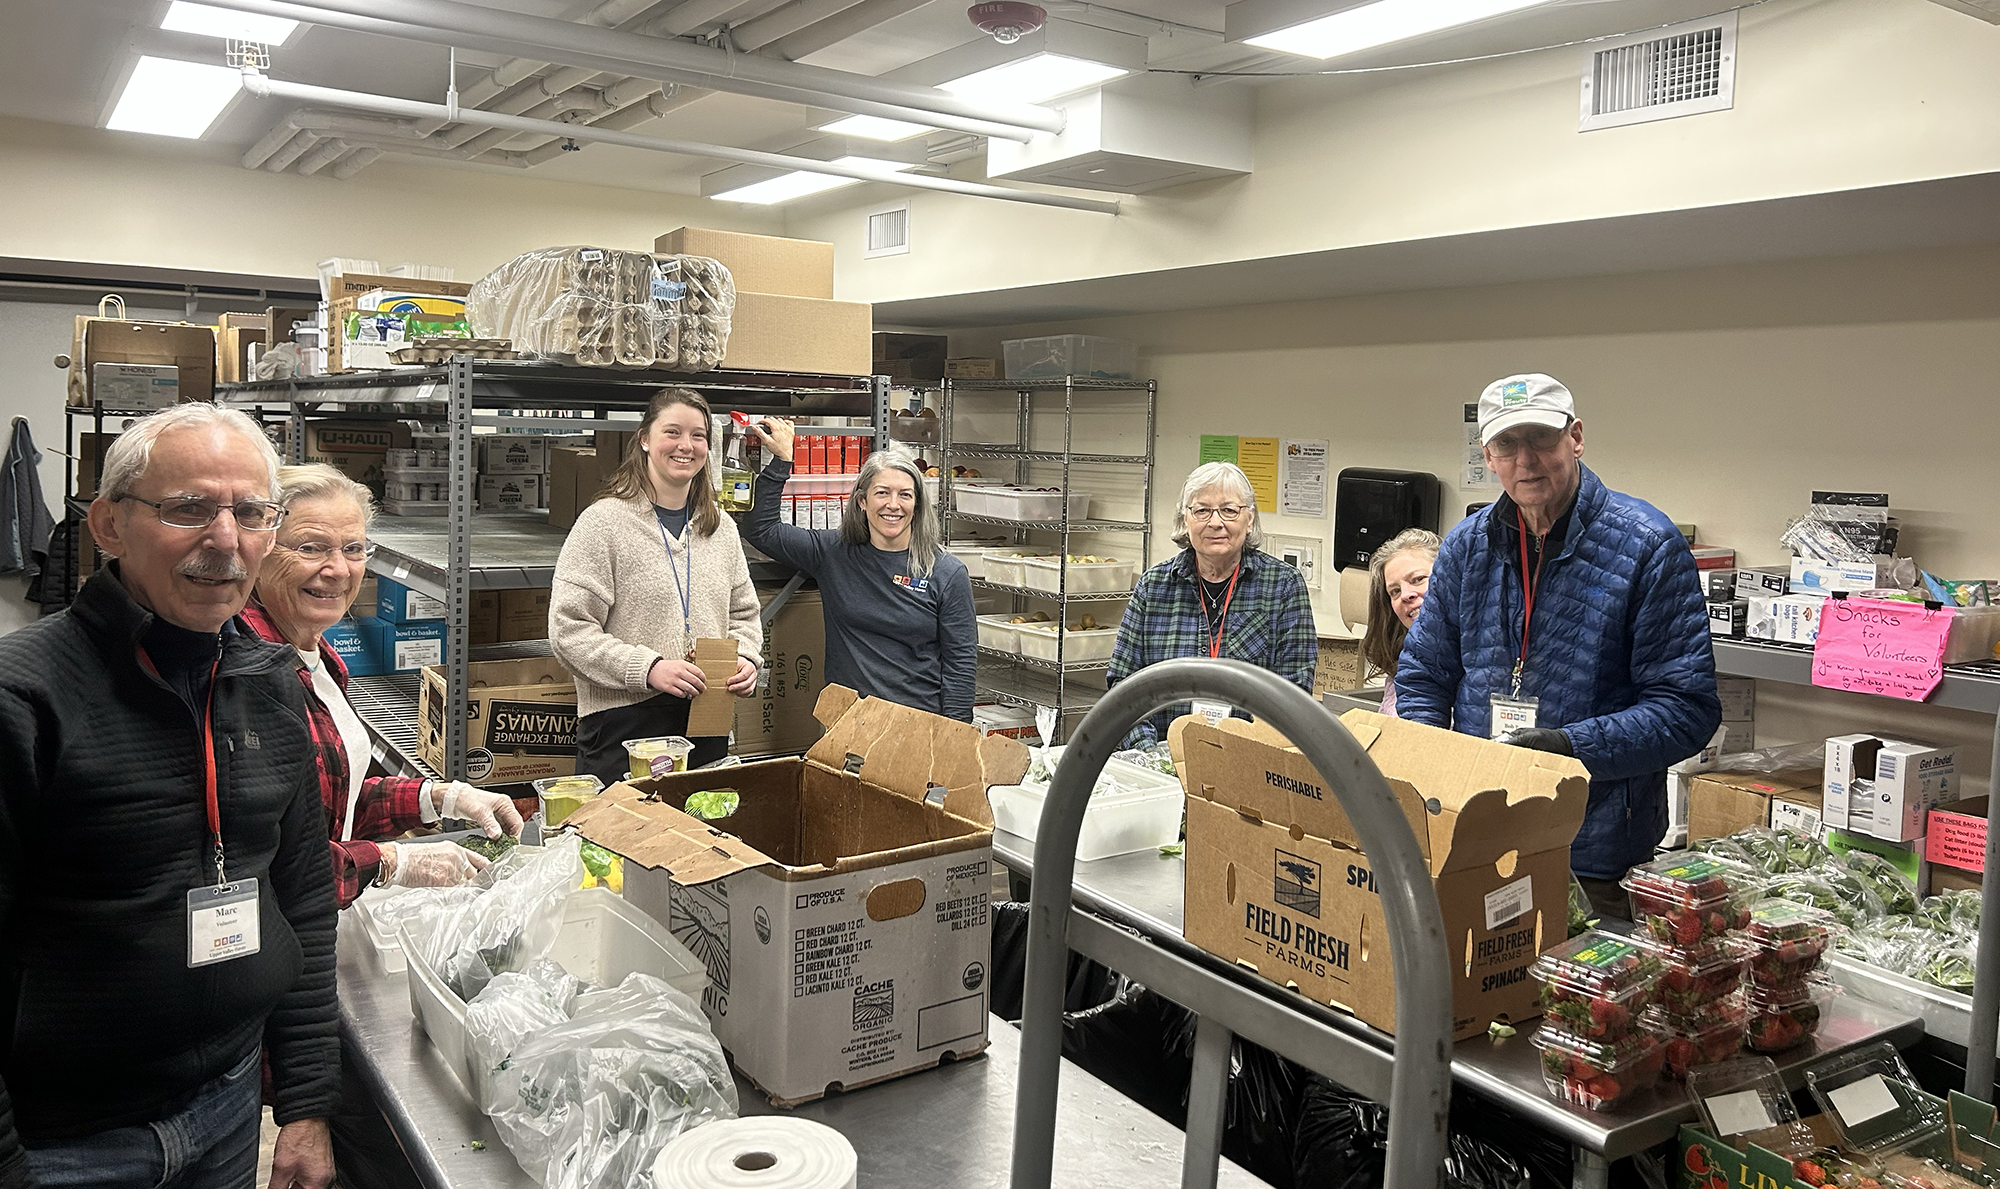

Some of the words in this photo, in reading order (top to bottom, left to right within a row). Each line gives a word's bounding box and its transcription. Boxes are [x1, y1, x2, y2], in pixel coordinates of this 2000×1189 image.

[979, 4, 1003, 14] FIRE
[322, 432, 388, 445] U-HAUL
[1836, 602, 1901, 626] Snacks
[395, 629, 410, 637] bowl
[333, 638, 353, 646] bowl
[776, 652, 785, 669] 1/6
[1863, 643, 1928, 663] Volunteers
[795, 654, 813, 693] CHOICE
[776, 680, 785, 698] #57
[763, 702, 774, 734] Sack
[494, 732, 549, 744] EXCHANGE
[553, 733, 577, 745] QUAL
[467, 764, 486, 772] USDA
[526, 766, 556, 775] ORGANIC
[1920, 759, 1932, 769] Get
[492, 770, 525, 779] BANANAS
[1265, 771, 1323, 801] PERISHABLE
[1945, 818, 1961, 826] THESE
[1962, 821, 1977, 829] BAGS
[1944, 844, 1960, 852] Bagels
[1943, 852, 1958, 860] Toilet
[1959, 856, 1974, 864] paper
[947, 863, 977, 874] PRODUCE
[956, 870, 978, 879] MEXICO
[809, 888, 845, 900] PRODUCE
[810, 899, 821, 907] OF
[822, 896, 844, 905] U.S.A.
[215, 907, 237, 917] Marc
[935, 902, 946, 912] RED
[947, 898, 963, 910] BEETS
[964, 897, 970, 907] 12
[971, 895, 979, 905] CT.
[936, 909, 963, 923] COLLARDS
[964, 908, 970, 917] 12
[971, 906, 979, 916] CT.
[806, 926, 825, 938] GREEN
[826, 922, 846, 934] CHARD
[848, 920, 855, 930] 12
[856, 918, 866, 929] CT.
[951, 920, 962, 931] DILL
[963, 919, 970, 929] 24
[971, 917, 979, 927] CT.
[806, 939, 818, 950] RED
[819, 935, 839, 947] CHARD
[840, 933, 848, 943] 12
[849, 931, 859, 941] CT.
[1245, 902, 1291, 945] FIELD
[1295, 922, 1350, 971] FRESH
[1478, 936, 1504, 959] FIELD
[1505, 928, 1534, 951] FRESH
[805, 948, 834, 961] RAINBOW
[834, 943, 854, 956] CHARD
[855, 941, 863, 951] 12
[864, 939, 873, 950] CT.
[1489, 949, 1522, 966] FARMS
[805, 960, 825, 973] GREEN
[826, 957, 841, 969] KALE
[842, 955, 850, 966] 12
[851, 953, 860, 964] CT.
[1265, 941, 1326, 978] FARMS
[805, 973, 817, 984] RED
[819, 970, 833, 982] KALE
[835, 968, 843, 979] 12
[843, 966, 853, 977] CT.
[1481, 965, 1527, 993] SPINACH
[805, 982, 829, 996] LACINTO
[831, 979, 845, 991] KALE
[847, 977, 854, 987] 12
[855, 975, 865, 986] CT.
[854, 979, 894, 996] CACHE
[852, 1015, 894, 1031] ORGANIC
[841, 1042, 867, 1054] CACHE
[868, 1033, 903, 1048] PRODUCE
[850, 1031, 886, 1044] DISTRIBUTED
